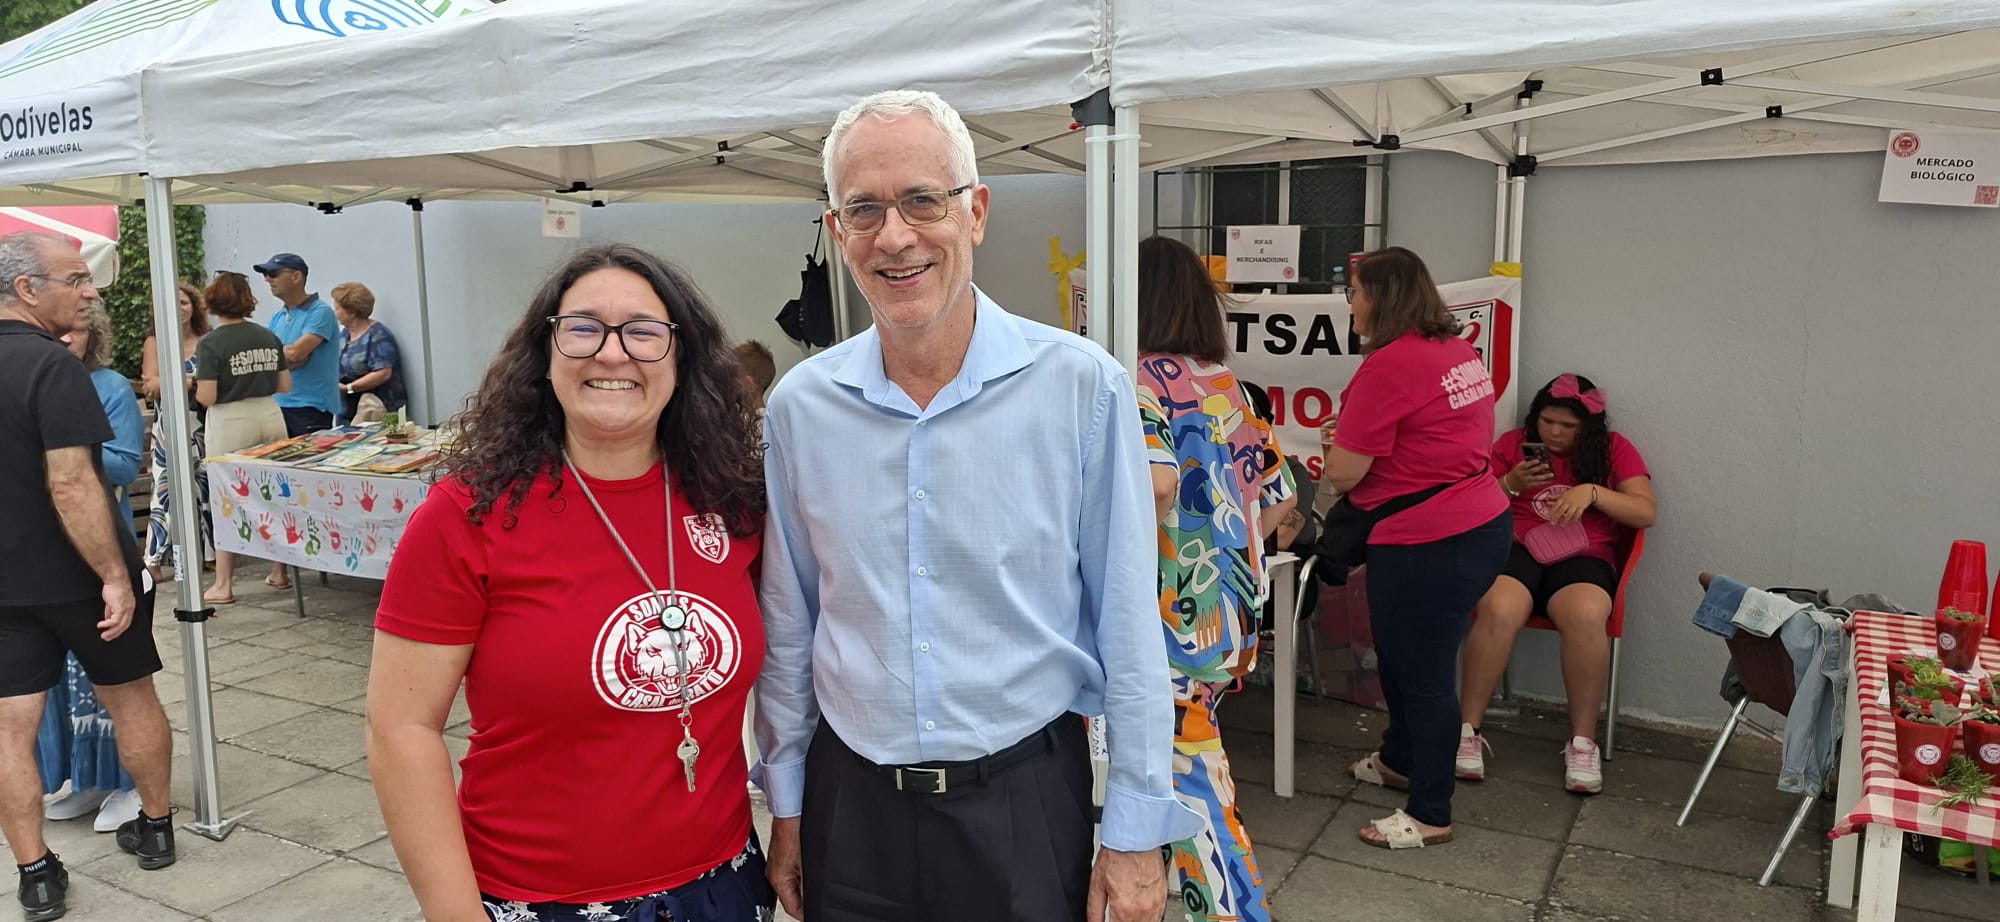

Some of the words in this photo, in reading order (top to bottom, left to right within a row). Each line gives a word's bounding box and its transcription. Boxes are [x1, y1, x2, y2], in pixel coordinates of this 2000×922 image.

[0, 102, 93, 142] Odivelas
[38, 142, 83, 156] MUNICIPAL
[1916, 157, 1974, 168] MERCADO
[1910, 170, 1975, 182] BIOLÓGICO
[229, 348, 279, 367] #SOMOS
[620, 687, 666, 708] CASAL
